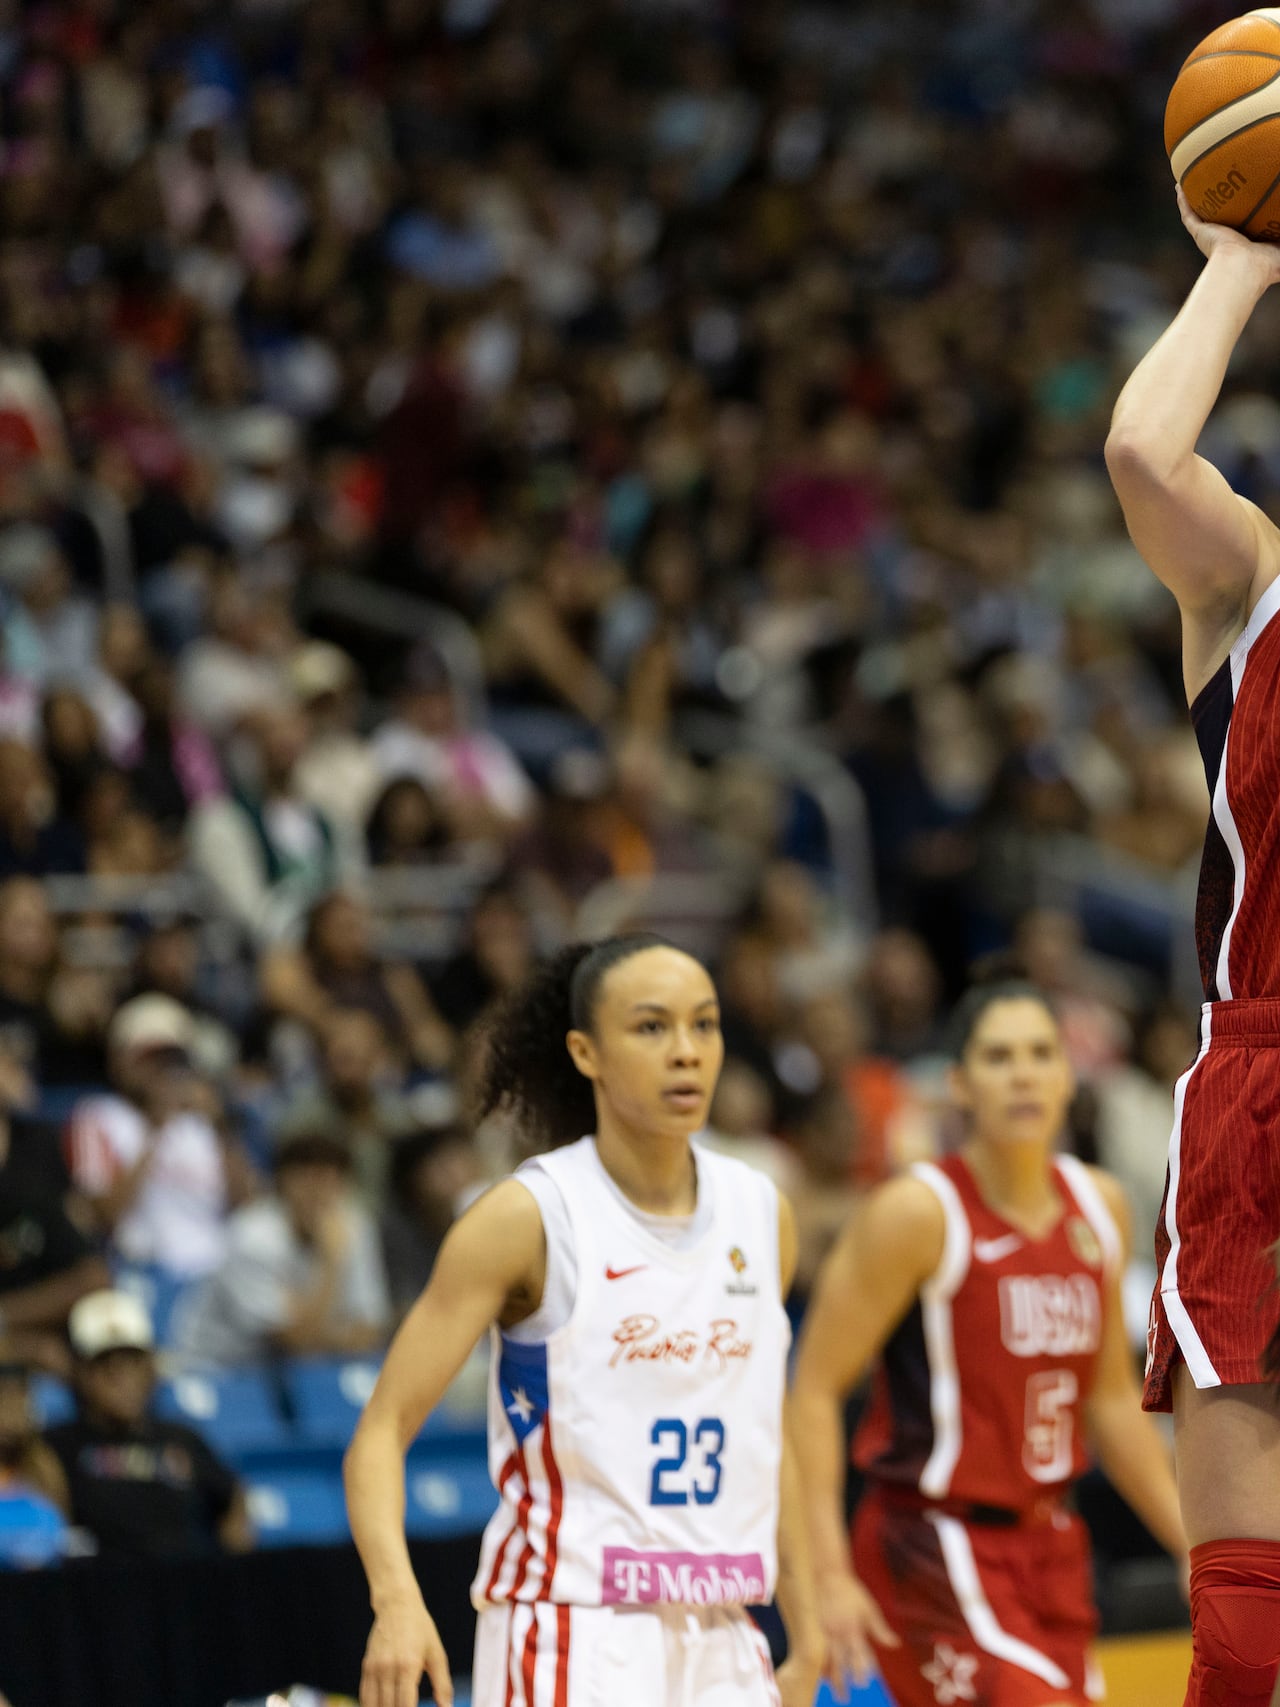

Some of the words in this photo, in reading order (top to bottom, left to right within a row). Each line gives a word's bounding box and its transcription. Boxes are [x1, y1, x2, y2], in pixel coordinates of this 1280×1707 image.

[998, 1272, 1101, 1357] USA
[650, 1417, 725, 1506] 23
[1021, 1369, 1078, 1484] 5
